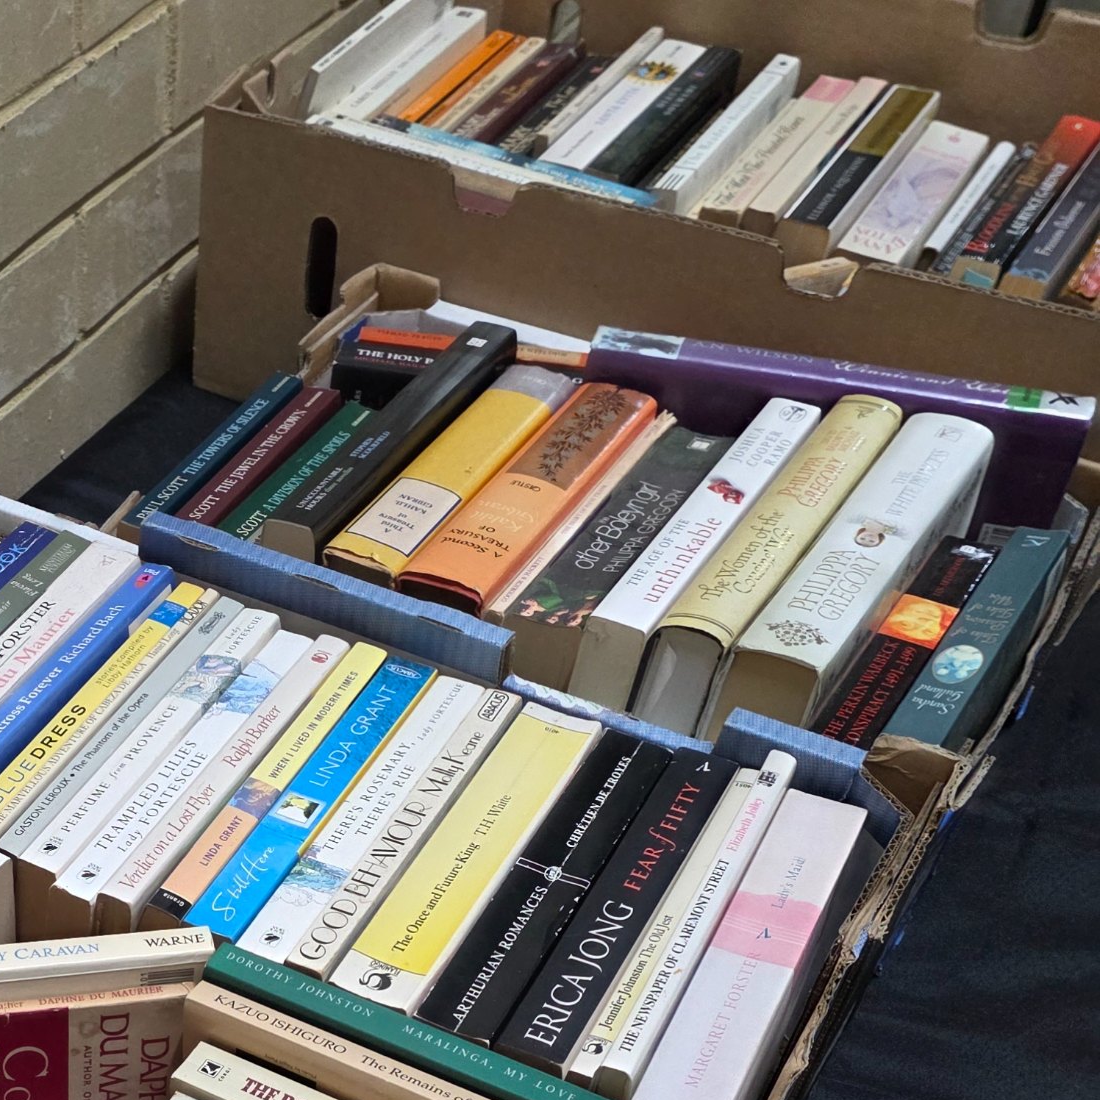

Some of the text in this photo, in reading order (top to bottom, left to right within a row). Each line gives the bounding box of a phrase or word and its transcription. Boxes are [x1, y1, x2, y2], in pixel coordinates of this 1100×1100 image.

[357, 348, 384, 358] THE
[387, 352, 422, 363] HOLY
[737, 344, 815, 364] WILSON
[728, 427, 768, 462] JOSHUA
[740, 431, 784, 467] COOPER
[763, 439, 795, 466] RAMO
[136, 498, 165, 520] PAUL
[236, 429, 353, 536] SCOTT A DIVISION OF THE SPOILS
[626, 518, 689, 586] THE AGE OF THE
[639, 517, 723, 603] unthinkable
[782, 547, 867, 611] PHILIPPA
[808, 555, 884, 621] GREGORY
[18, 667, 62, 705] Forever
[59, 627, 102, 664] Richard
[94, 603, 125, 627] Bach
[836, 681, 872, 719] PERKIN
[862, 642, 902, 684] WARBECK
[269, 757, 291, 779] WHEN
[290, 731, 311, 752] LIVED
[305, 721, 319, 731] IN
[314, 692, 342, 722] MODERN
[337, 671, 359, 691] TIMES
[912, 695, 956, 715] Sandra
[391, 794, 512, 953] The Once and Future King T.H. White
[14, 942, 99, 959] CARAVAN
[146, 932, 204, 948] WARNE
[453, 886, 548, 1021] ARTHURIAN ROMANCES
[524, 900, 638, 1046] ERICA JONG
[618, 859, 730, 1052] THE NEWSPAPER OF CLAREMONT STREET
[215, 994, 270, 1021] KAZUO
[271, 1018, 347, 1054] ISHIGURO
[361, 1054, 387, 1072] The
[389, 1067, 451, 1098] Remains
[226, 952, 289, 983] DOROTHY
[296, 982, 373, 1017] JOHNSTON
[402, 1025, 493, 1069] MARALINGA,
[503, 1067, 528, 1082] MY
